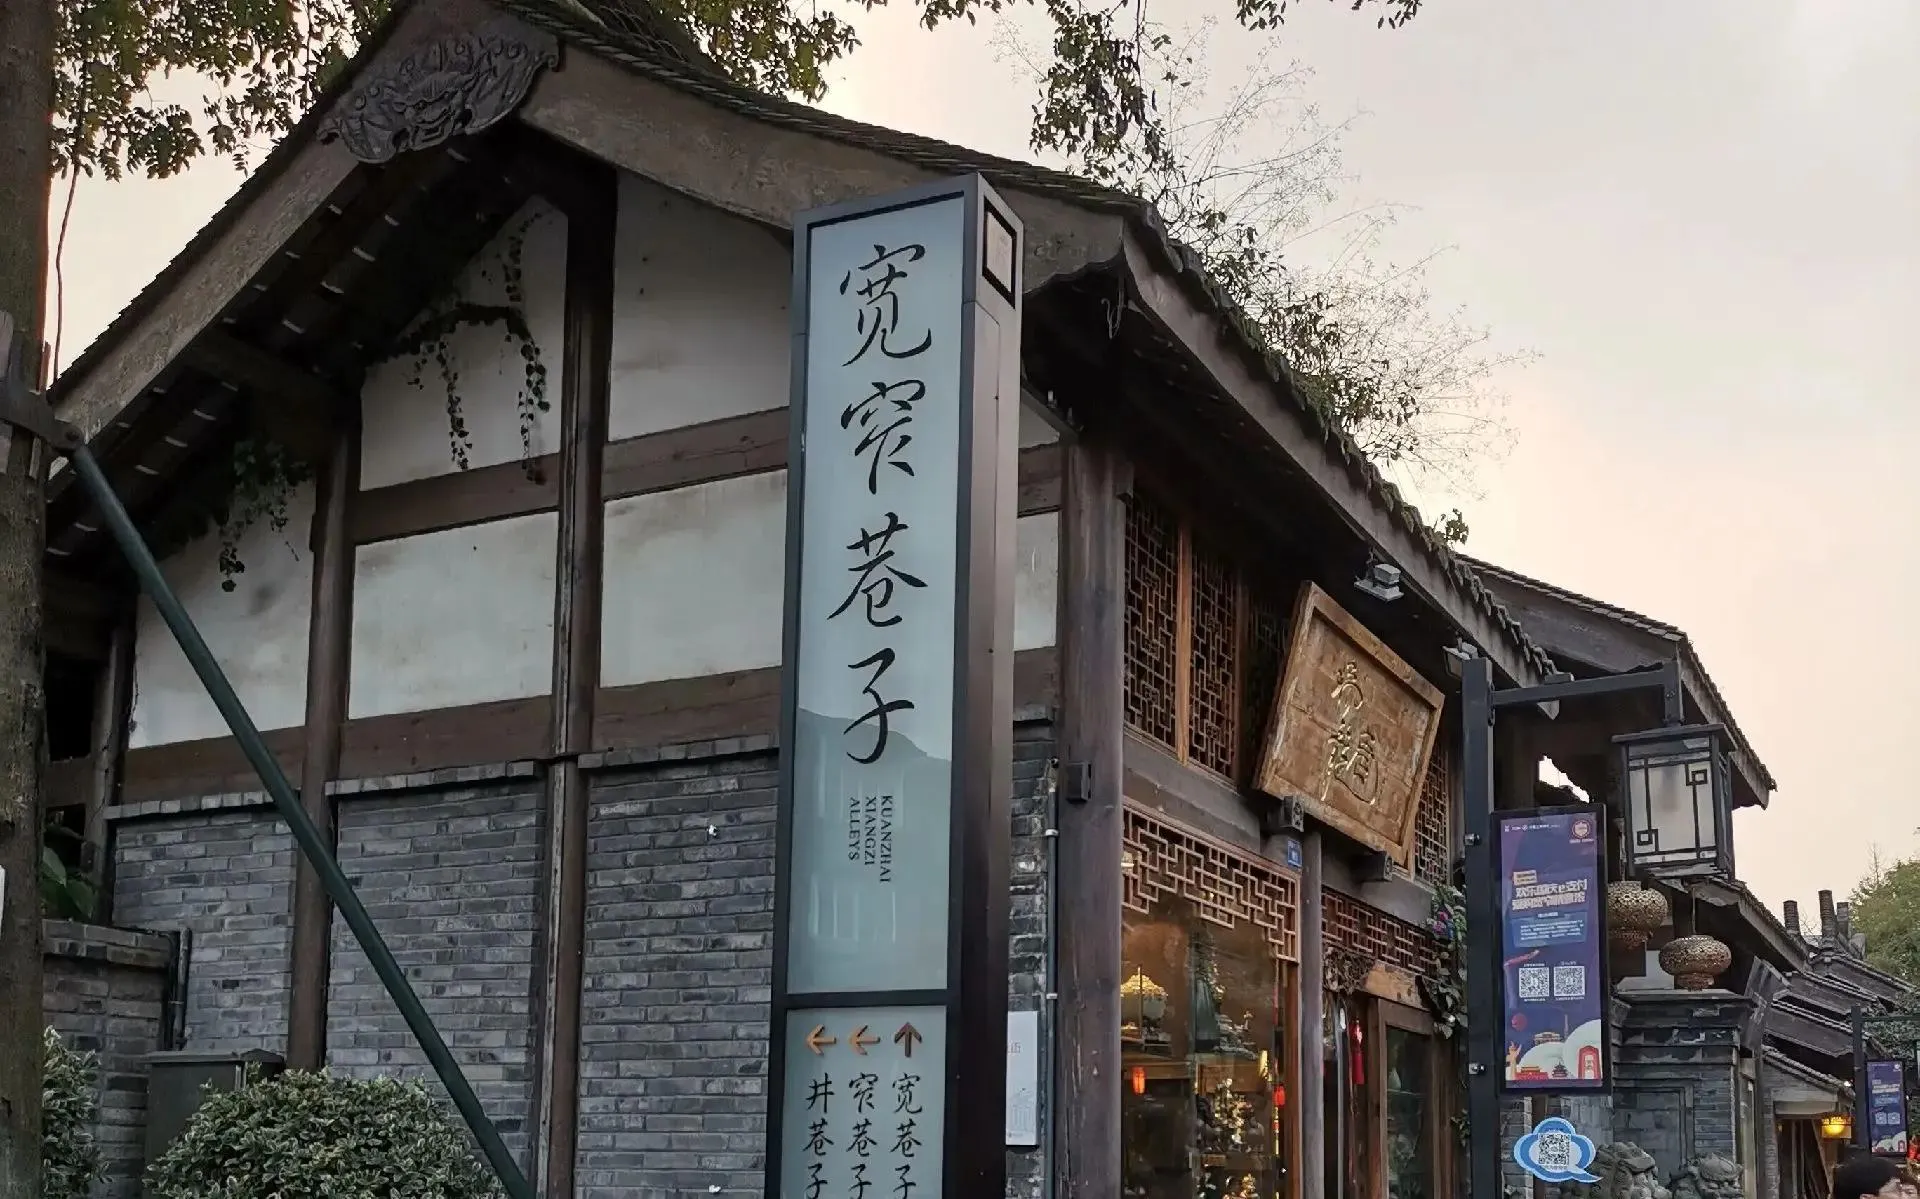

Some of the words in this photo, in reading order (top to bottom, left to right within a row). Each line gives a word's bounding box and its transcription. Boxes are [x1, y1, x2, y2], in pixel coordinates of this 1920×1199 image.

[827, 243, 932, 765] 宽窄巷子
[848, 797, 861, 861] ALLEYS
[864, 796, 877, 866] XIANGZI
[879, 795, 893, 883] KUANZHAI
[802, 1072, 835, 1199] 井巷子
[847, 1072, 879, 1199] 窄巷子
[889, 1072, 923, 1199] 宽巷子
